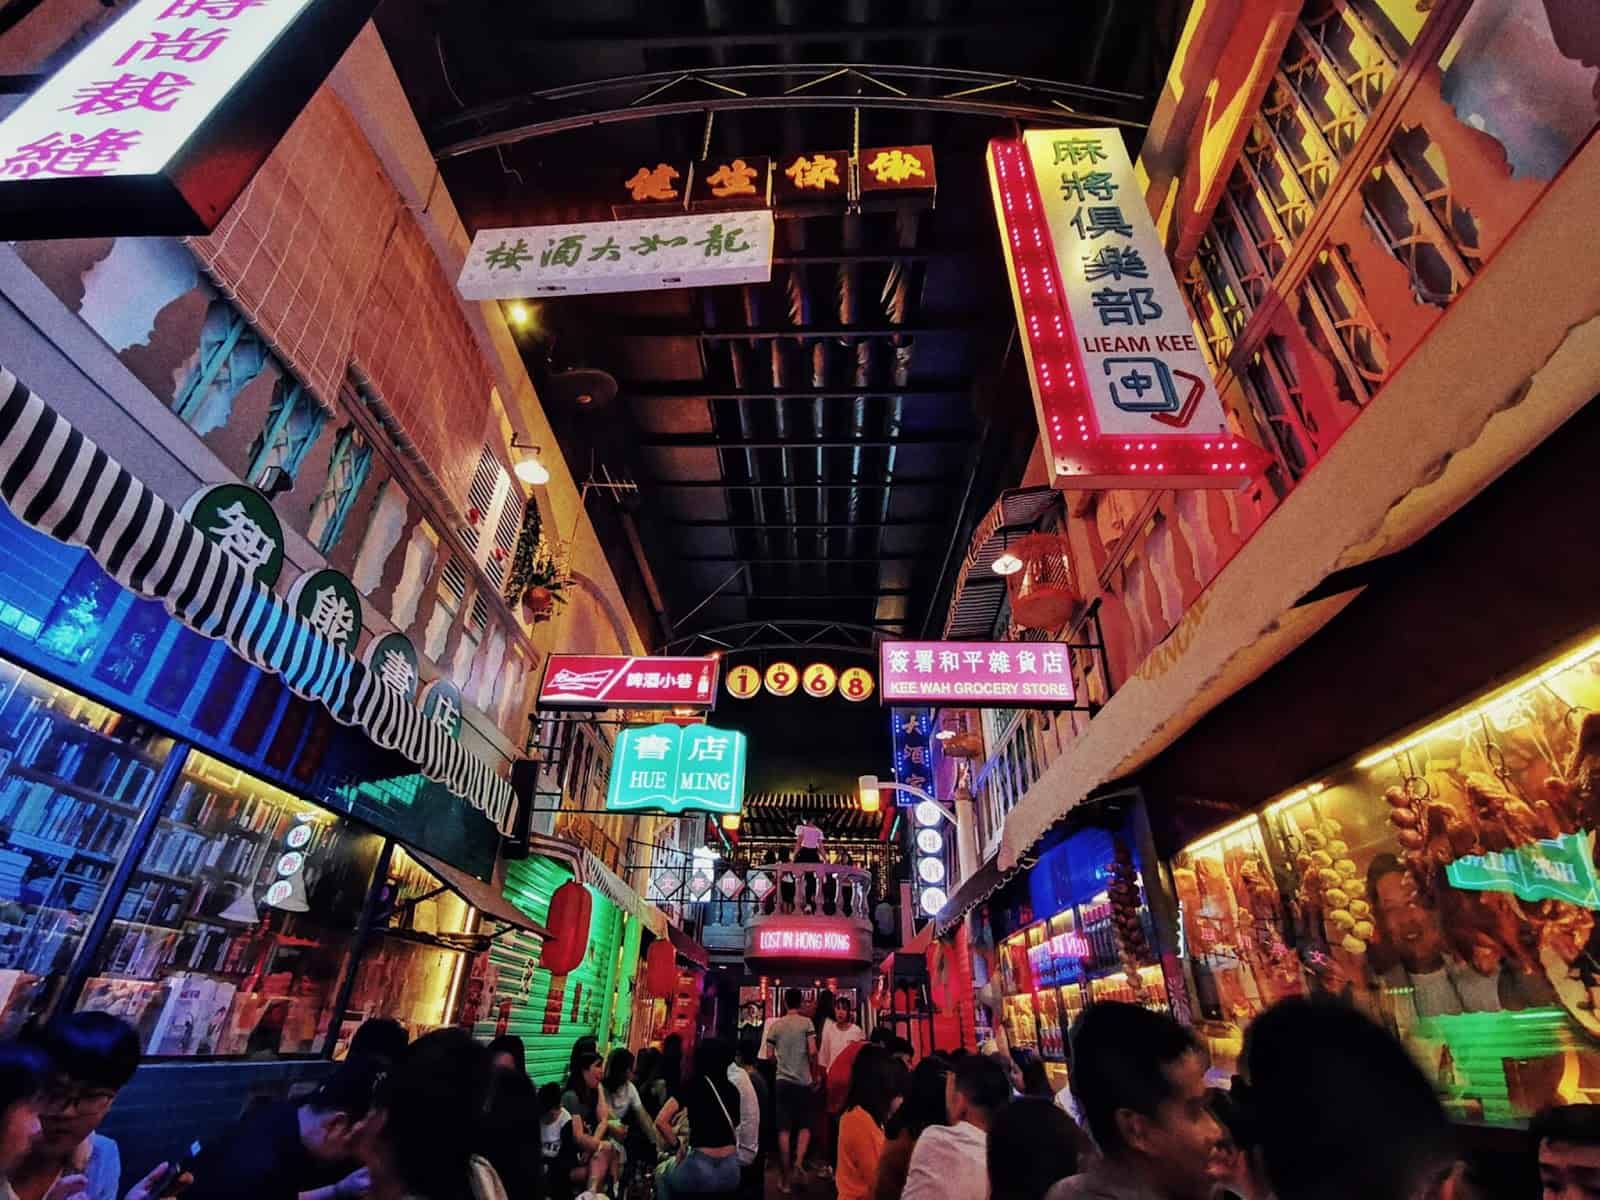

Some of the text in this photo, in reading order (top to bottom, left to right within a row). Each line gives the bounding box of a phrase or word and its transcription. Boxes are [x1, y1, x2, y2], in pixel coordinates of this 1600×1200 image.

[1052, 137, 1163, 326] 麻將俱樂部
[1083, 334, 1197, 353] LIEAM KEE
[626, 672, 693, 689] 啤酒小巷
[891, 681, 1069, 695] KEE WAH GROCERY STORE
[634, 733, 729, 761] 書店
[629, 770, 731, 791] HUE MING
[760, 931, 850, 951] LOST IN HONG KONG
